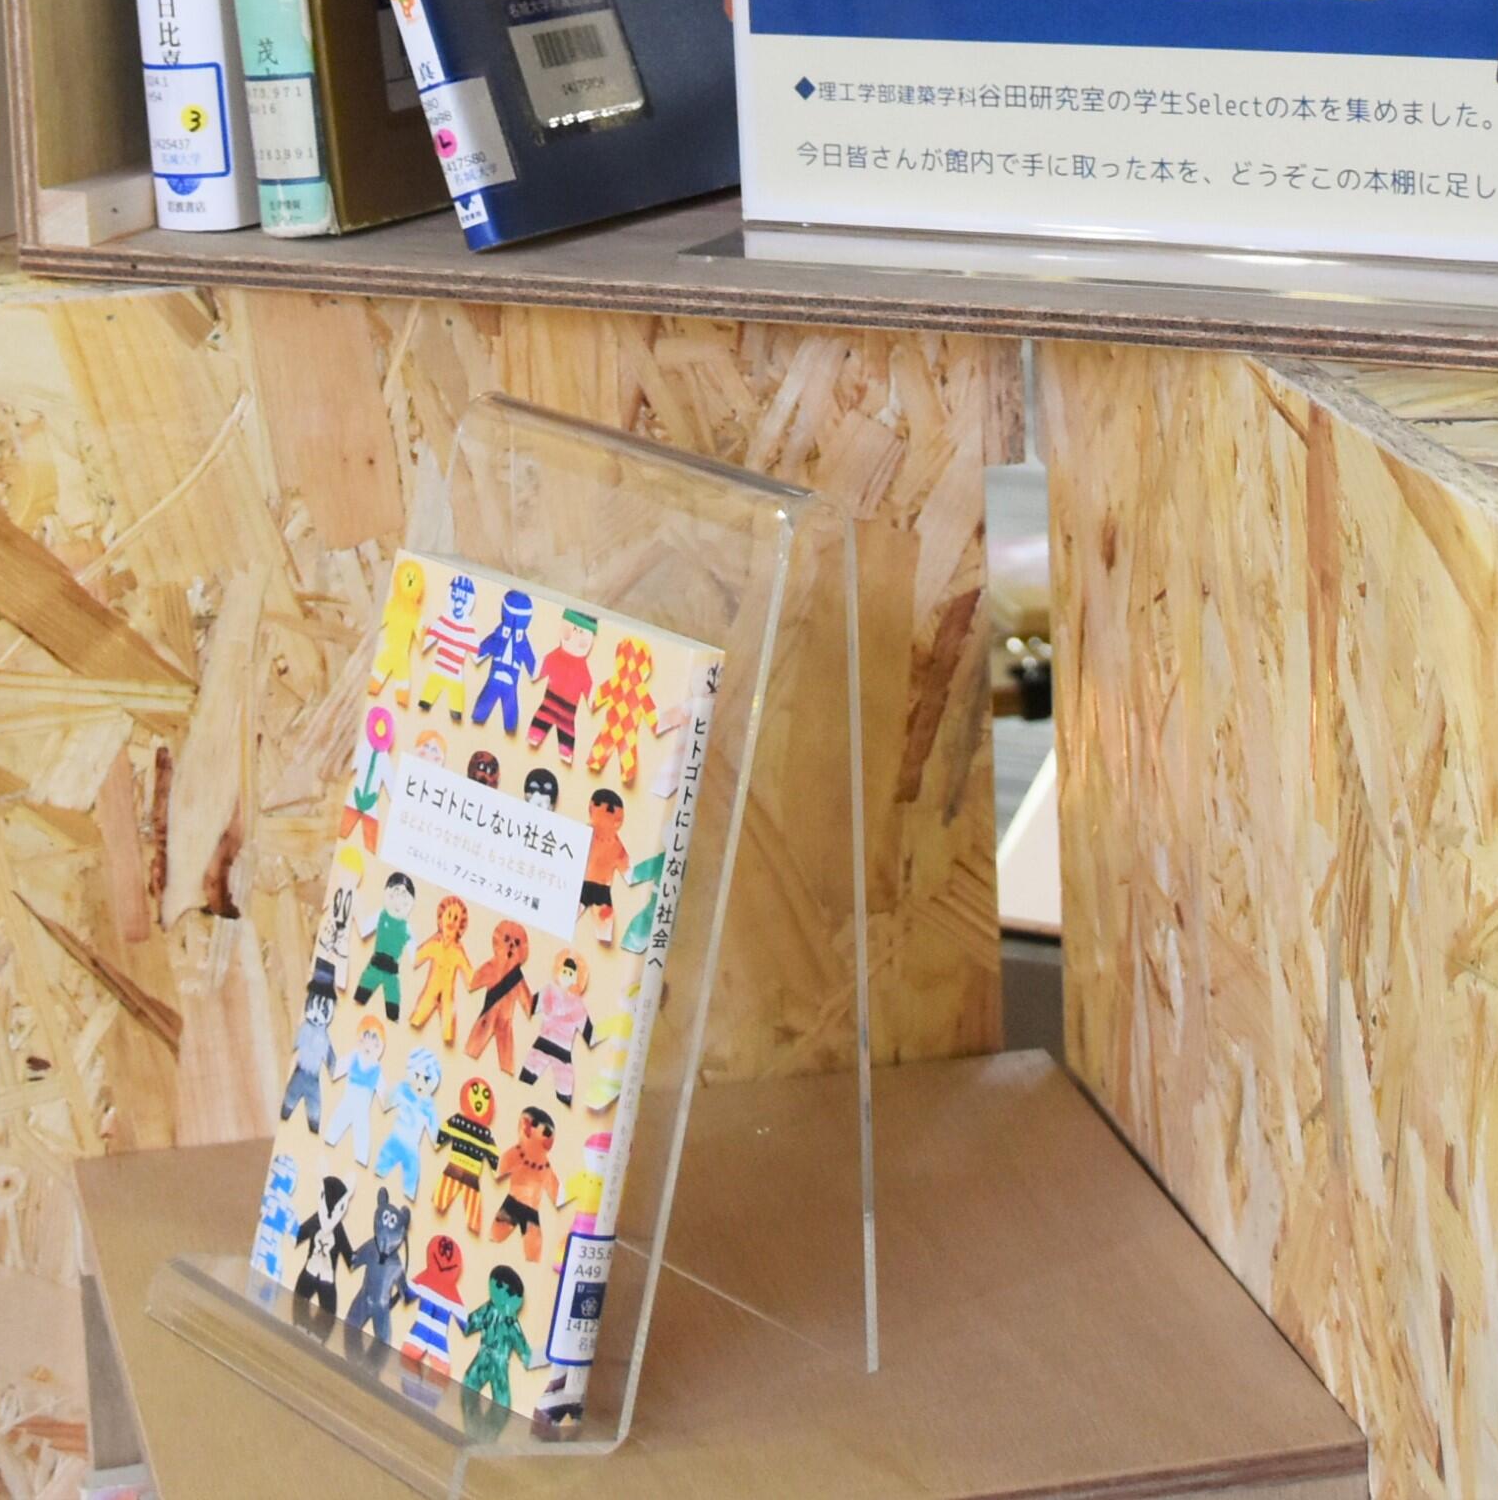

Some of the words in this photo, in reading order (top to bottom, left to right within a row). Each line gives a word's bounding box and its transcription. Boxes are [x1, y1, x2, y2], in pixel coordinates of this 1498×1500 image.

[405, 775, 575, 860] ヒトゴトにしない社会へ
[648, 717, 707, 969] ヒトゴトにしない社会へ
[574, 1264, 602, 1278] A49
